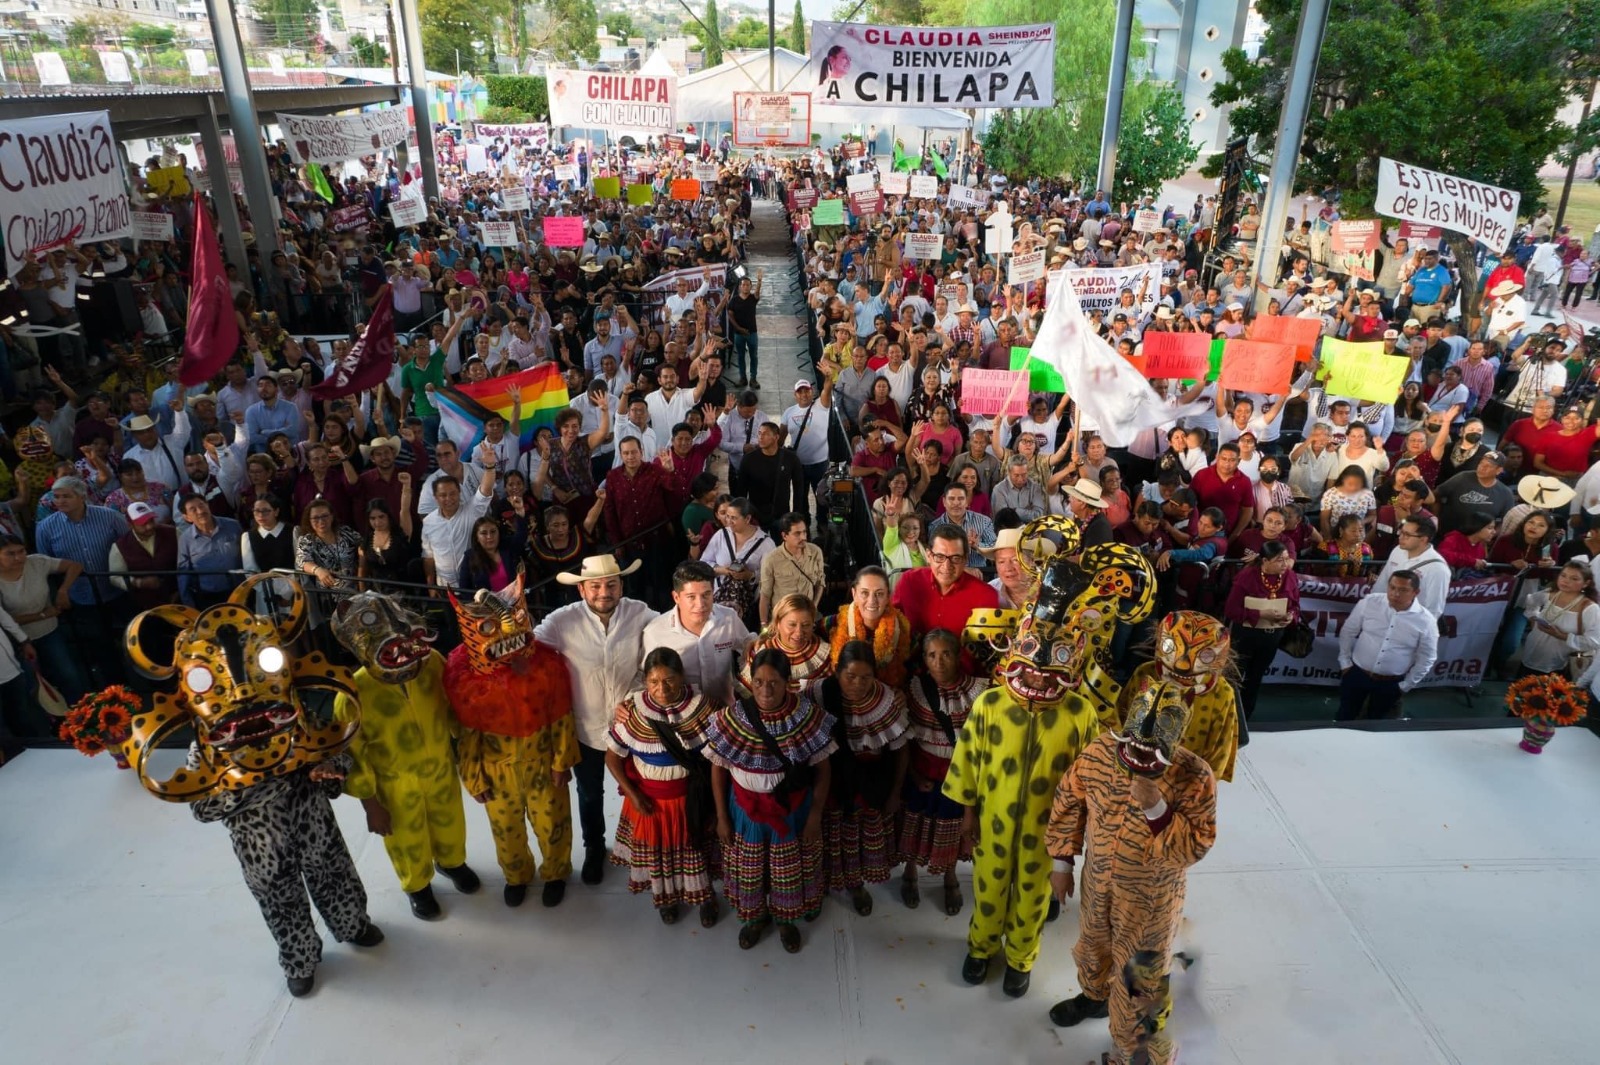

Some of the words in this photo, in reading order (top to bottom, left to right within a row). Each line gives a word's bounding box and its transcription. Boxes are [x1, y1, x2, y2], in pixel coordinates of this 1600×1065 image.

[864, 28, 983, 47] CLAUDIA
[988, 27, 1051, 40] SHEINBAUM
[892, 50, 1012, 68] BIENVENIDA
[587, 75, 669, 103] CHILAPA
[826, 80, 841, 99] A
[854, 71, 1040, 102] CHILAPA
[582, 101, 612, 125] CON
[614, 103, 672, 129] CLAUDIA
[0, 122, 115, 192] Claudia
[1394, 161, 1421, 190] Es
[1421, 170, 1514, 212] Tiempo
[1392, 190, 1419, 217] de
[1422, 194, 1451, 223] las
[1072, 276, 1117, 287] LAUDIA
[1079, 298, 1113, 308] DULTOS
[1298, 581, 1371, 599] RDINAC
[1449, 582, 1509, 599] ICIPAL
[1281, 665, 1299, 677] la
[1301, 666, 1342, 680] Unid
[1433, 658, 1482, 676] ena
